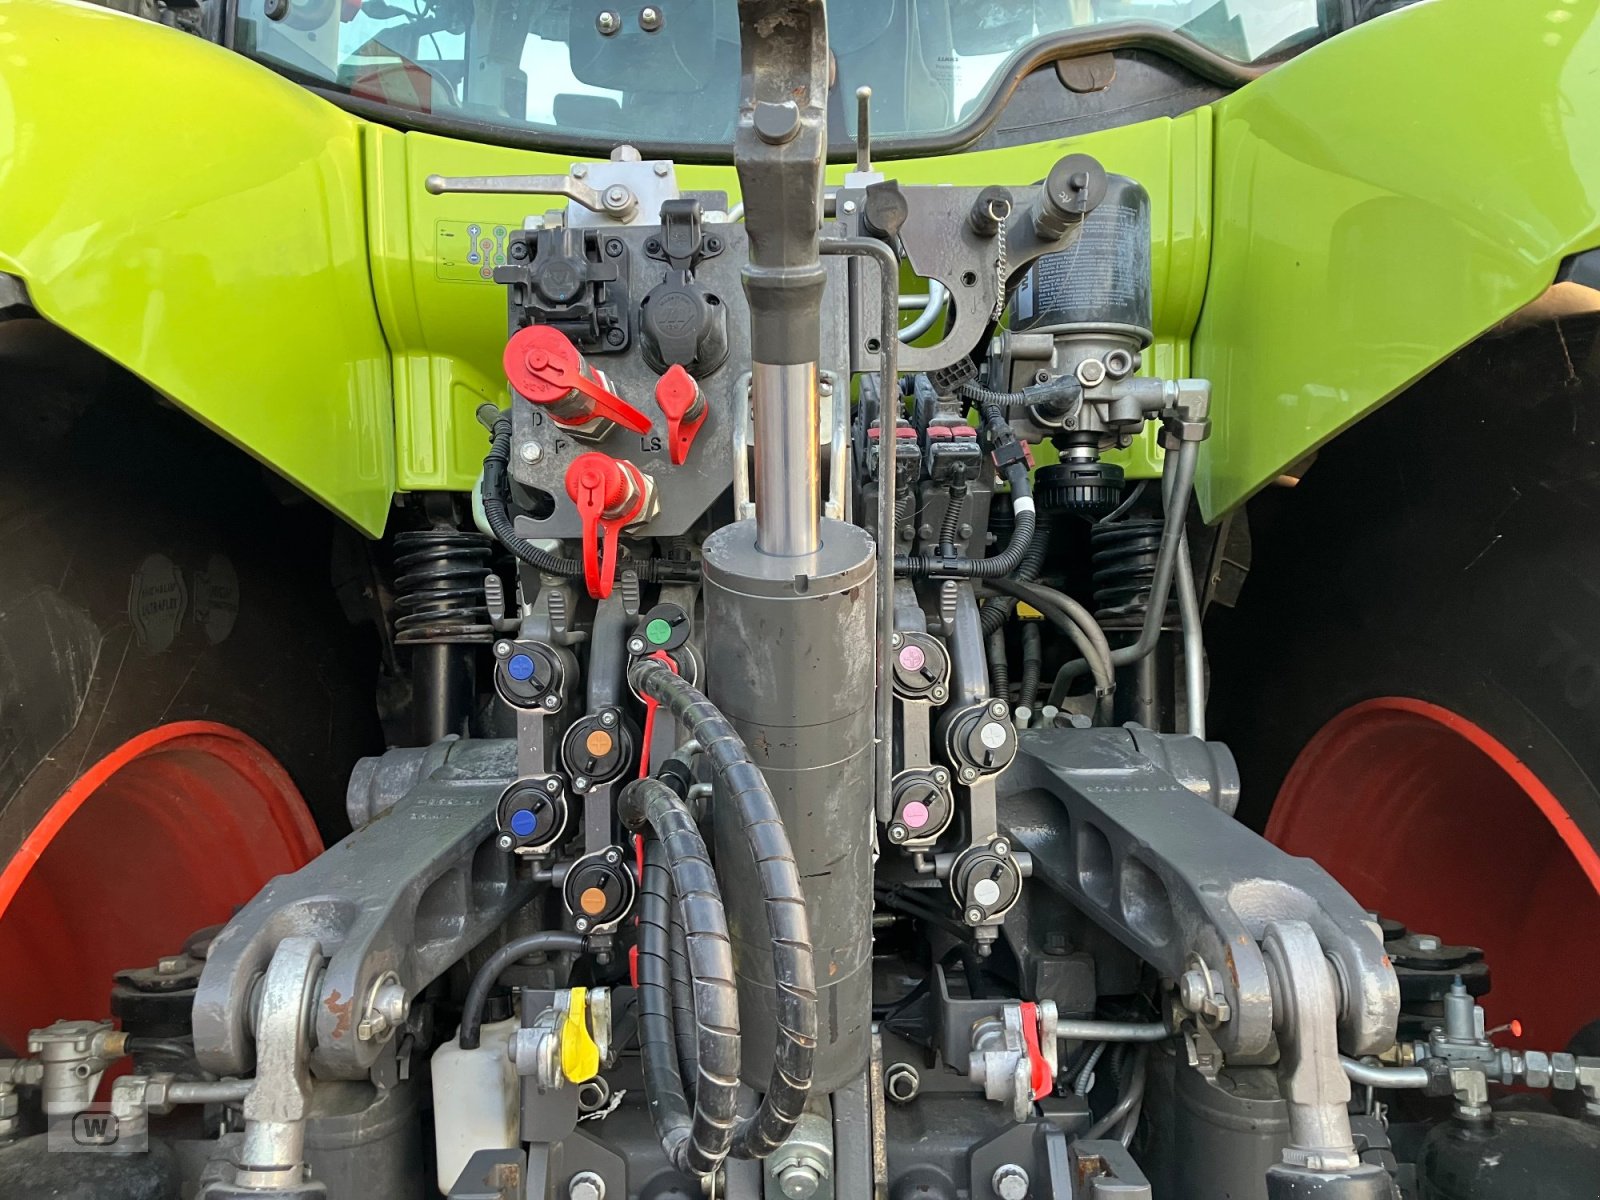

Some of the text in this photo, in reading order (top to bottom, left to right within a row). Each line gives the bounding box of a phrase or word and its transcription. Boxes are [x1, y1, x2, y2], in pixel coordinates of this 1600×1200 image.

[532, 412, 543, 428] D
[555, 439, 567, 454] P
[640, 437, 662, 452] LS
